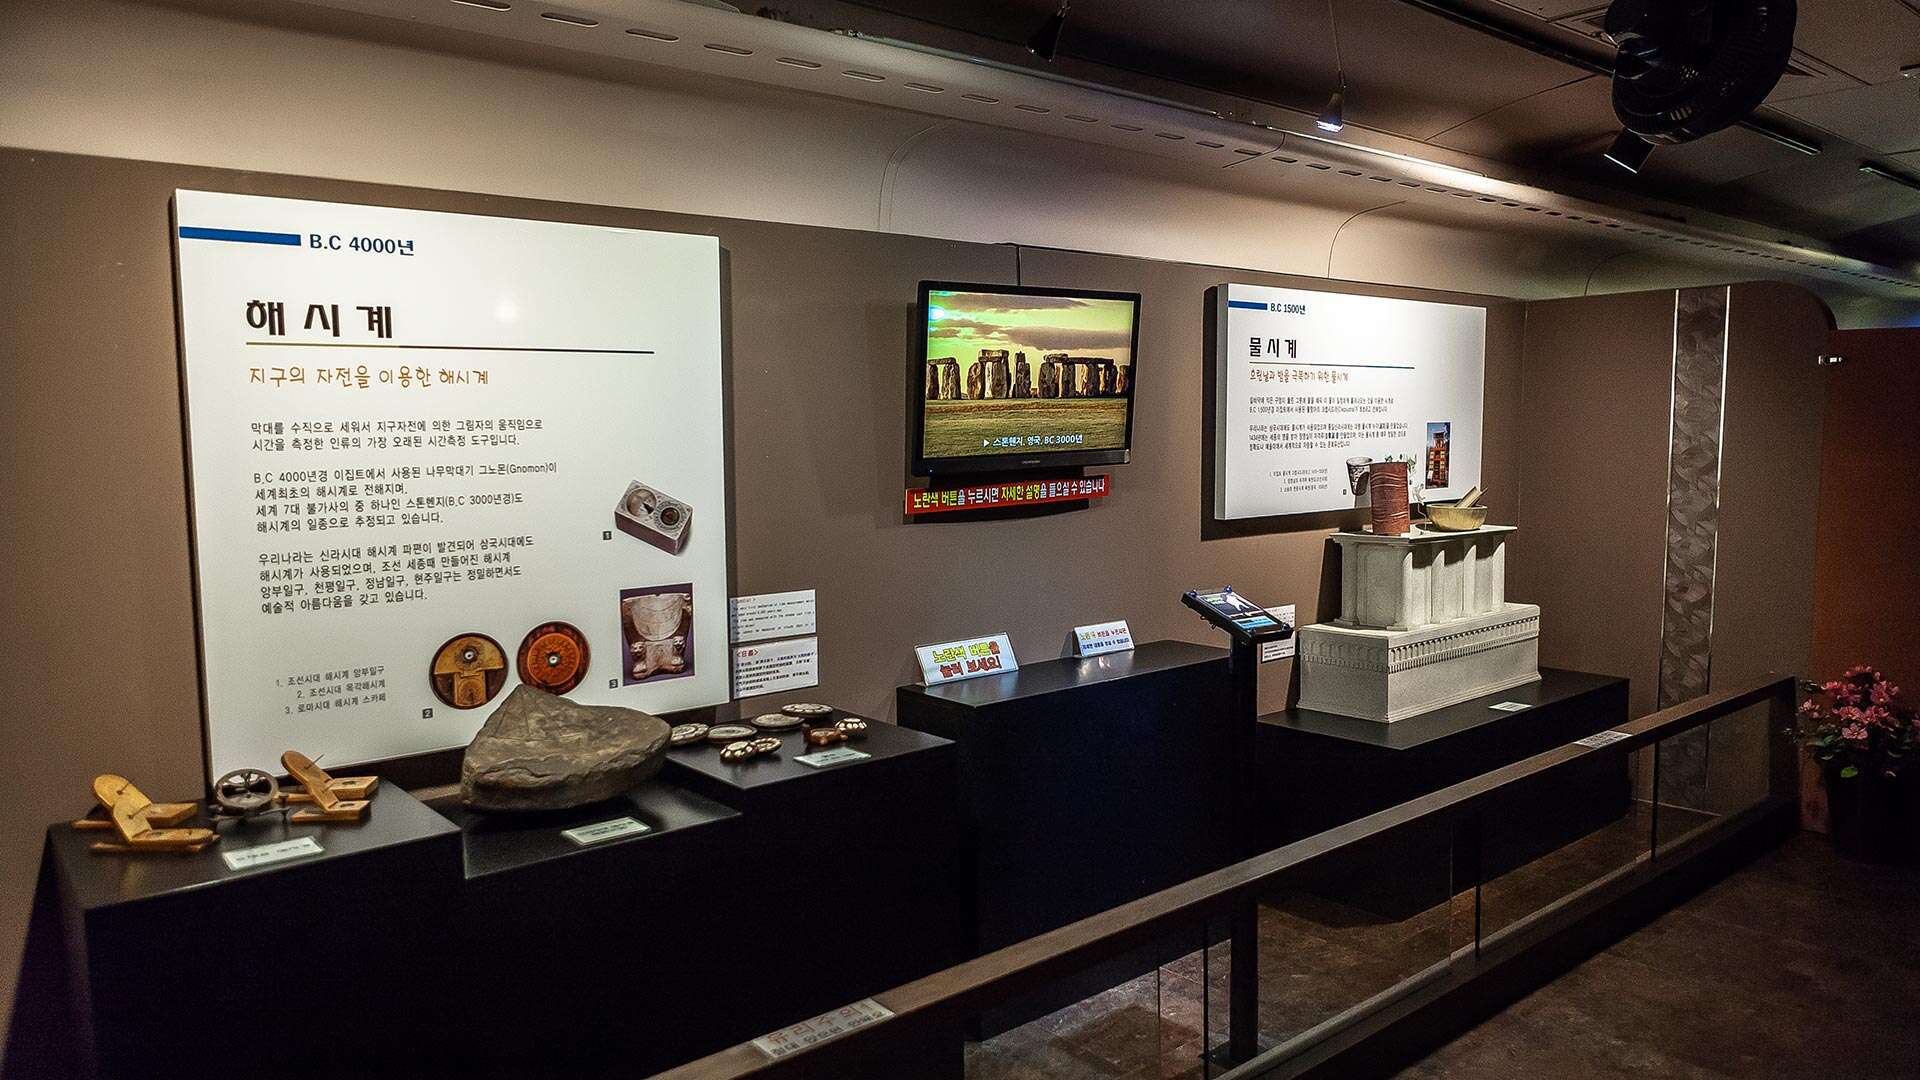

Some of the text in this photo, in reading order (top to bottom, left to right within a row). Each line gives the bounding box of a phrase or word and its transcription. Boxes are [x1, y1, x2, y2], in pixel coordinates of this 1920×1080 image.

[310, 233, 414, 256] B.C 4000년
[1270, 303, 1306, 315] B.C 1500년
[250, 365, 488, 389] 지구의 자전을 이용한 해시계
[251, 419, 543, 435] 막대를 수직으로 세워서 지구자전에 의한 그림자의 움직임으로
[252, 434, 520, 451] 시간을 측정한 인류의 가장 오래된 시간측정 도구입니다.
[1055, 434, 1083, 444] 3000년
[254, 472, 273, 484] B.C
[279, 470, 328, 483] 4000년경
[334, 468, 386, 480] 이집트에서
[391, 466, 421, 479] 사용된
[426, 465, 474, 478] 나무막대기
[255, 486, 310, 500] 세계최초의
[316, 485, 359, 498] 해시계로
[914, 478, 1105, 508] 노란색 버튼을 누르시면 자세한 설명을 들으실 수 있습니다
[256, 505, 277, 517] 세계
[283, 503, 300, 515] 7대
[307, 501, 349, 514] 불가사의
[355, 500, 364, 512] 중
[370, 499, 401, 511] 하나인
[257, 511, 443, 533] 해시계의 일종으로 추정되고 있습니다.
[259, 535, 534, 565] 우리나라는 신라시대 해시계 파편이 발견되어 삼국시대에도
[260, 568, 303, 582] 해시계가
[382, 560, 401, 572] 조선
[406, 557, 435, 570] 세종때
[441, 554, 479, 568] 만들어진
[483, 551, 511, 565] 해시계
[414, 571, 462, 585] 현주일구는
[467, 565, 521, 581] 정밀하면서도
[261, 588, 428, 615] 예술적 아름다움을 갖고 있습니다.
[932, 641, 1000, 663] 노란색 버튼을
